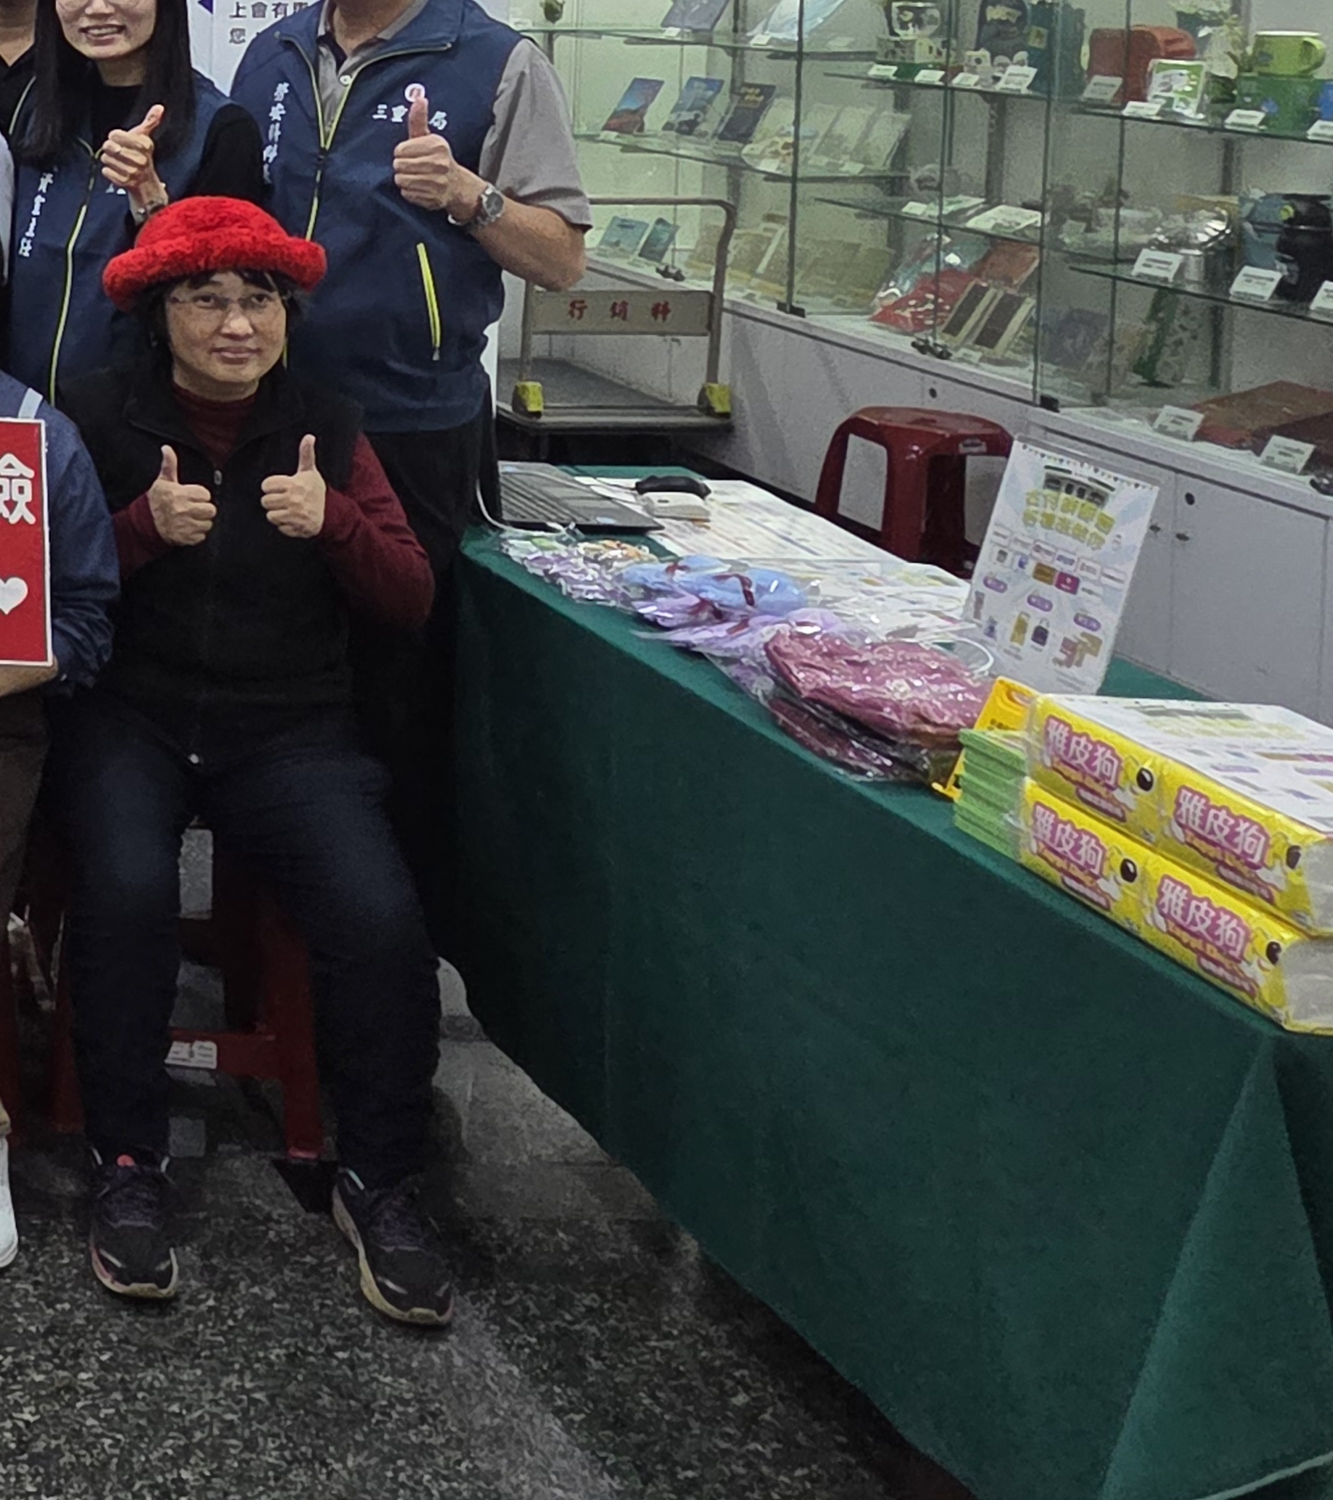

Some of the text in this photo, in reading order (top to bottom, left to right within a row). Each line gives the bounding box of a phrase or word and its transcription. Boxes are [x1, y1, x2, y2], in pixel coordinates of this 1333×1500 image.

[372, 104, 448, 131] 三重局
[1046, 718, 1120, 789] 雅皮狗
[1034, 803, 1104, 877] 雅皮狗
[1175, 787, 1266, 864] 雅皮狗
[1159, 878, 1245, 959] 雅皮狗
